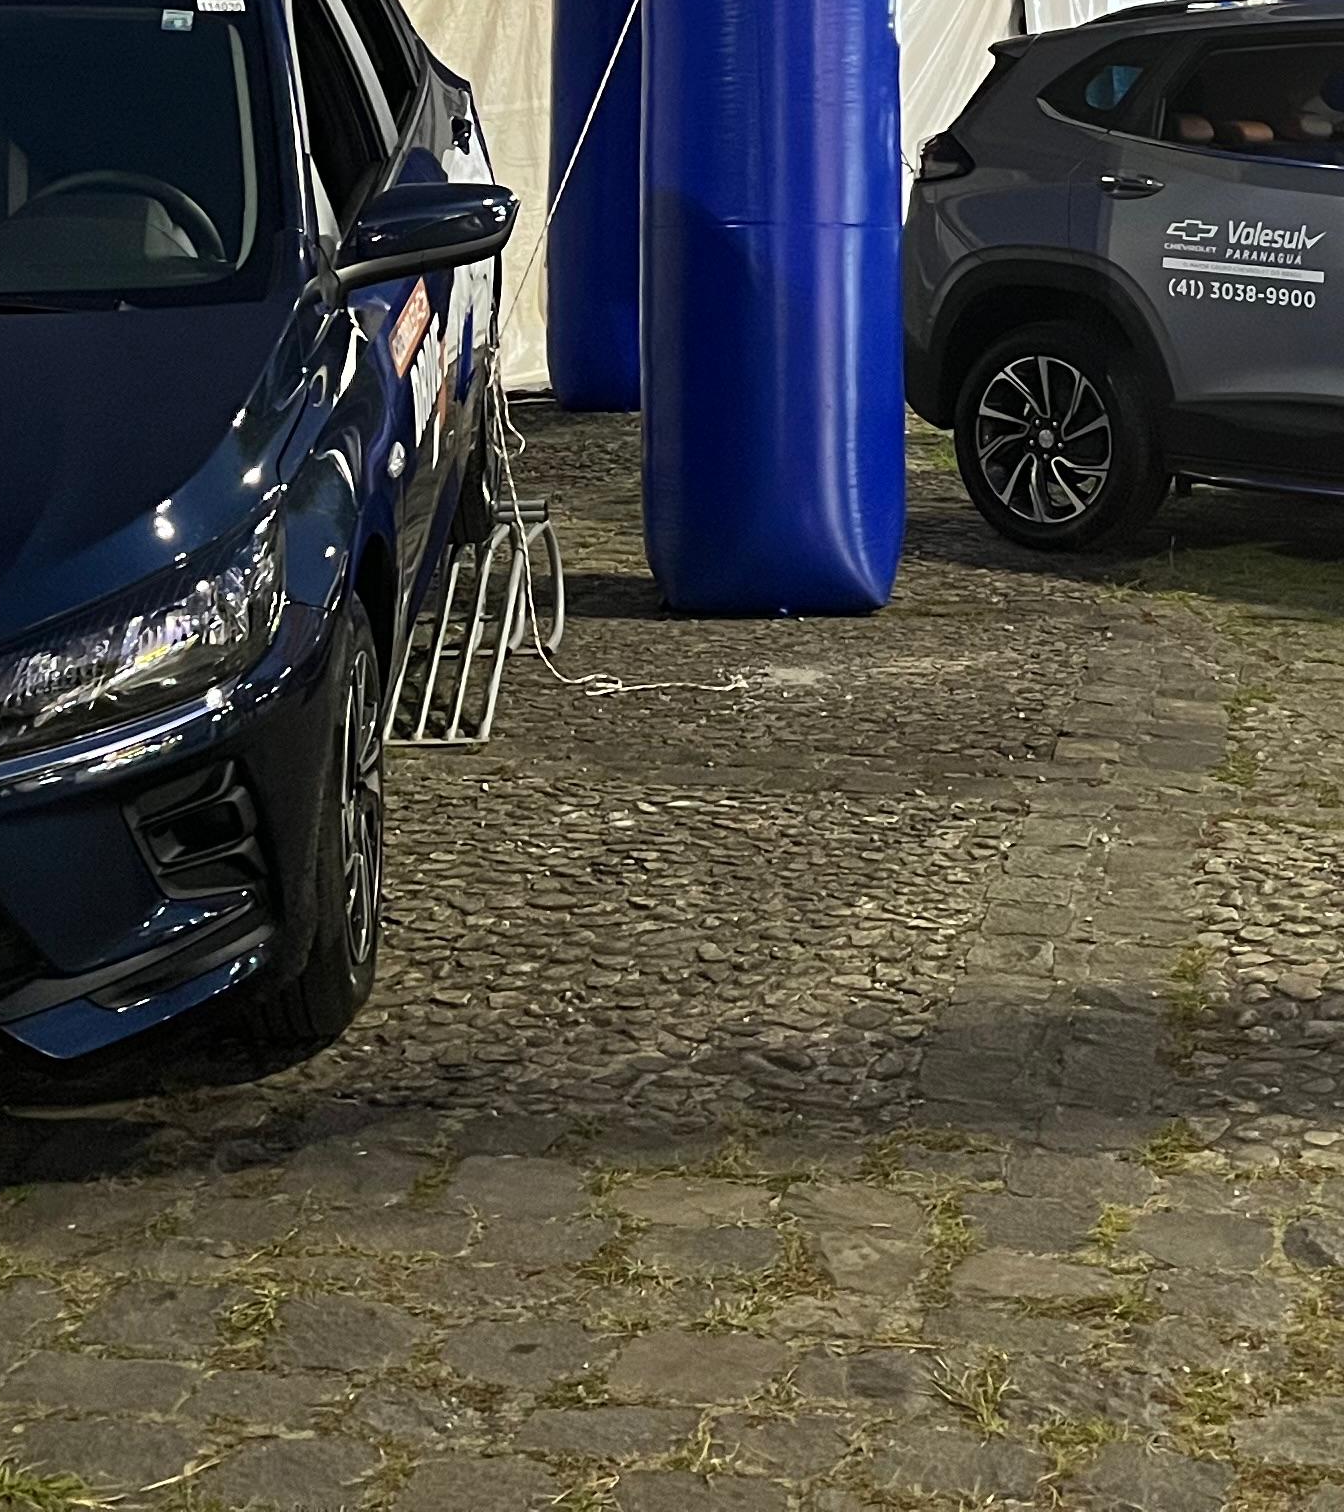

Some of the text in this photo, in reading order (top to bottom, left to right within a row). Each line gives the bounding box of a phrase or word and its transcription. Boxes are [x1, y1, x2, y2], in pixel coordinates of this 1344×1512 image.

[1227, 220, 1307, 250] Valesul
[1163, 242, 1217, 254] CHEVROLET
[1225, 248, 1303, 266] PARANAGUÁ
[1168, 278, 1316, 309] (41) 3038-9900
